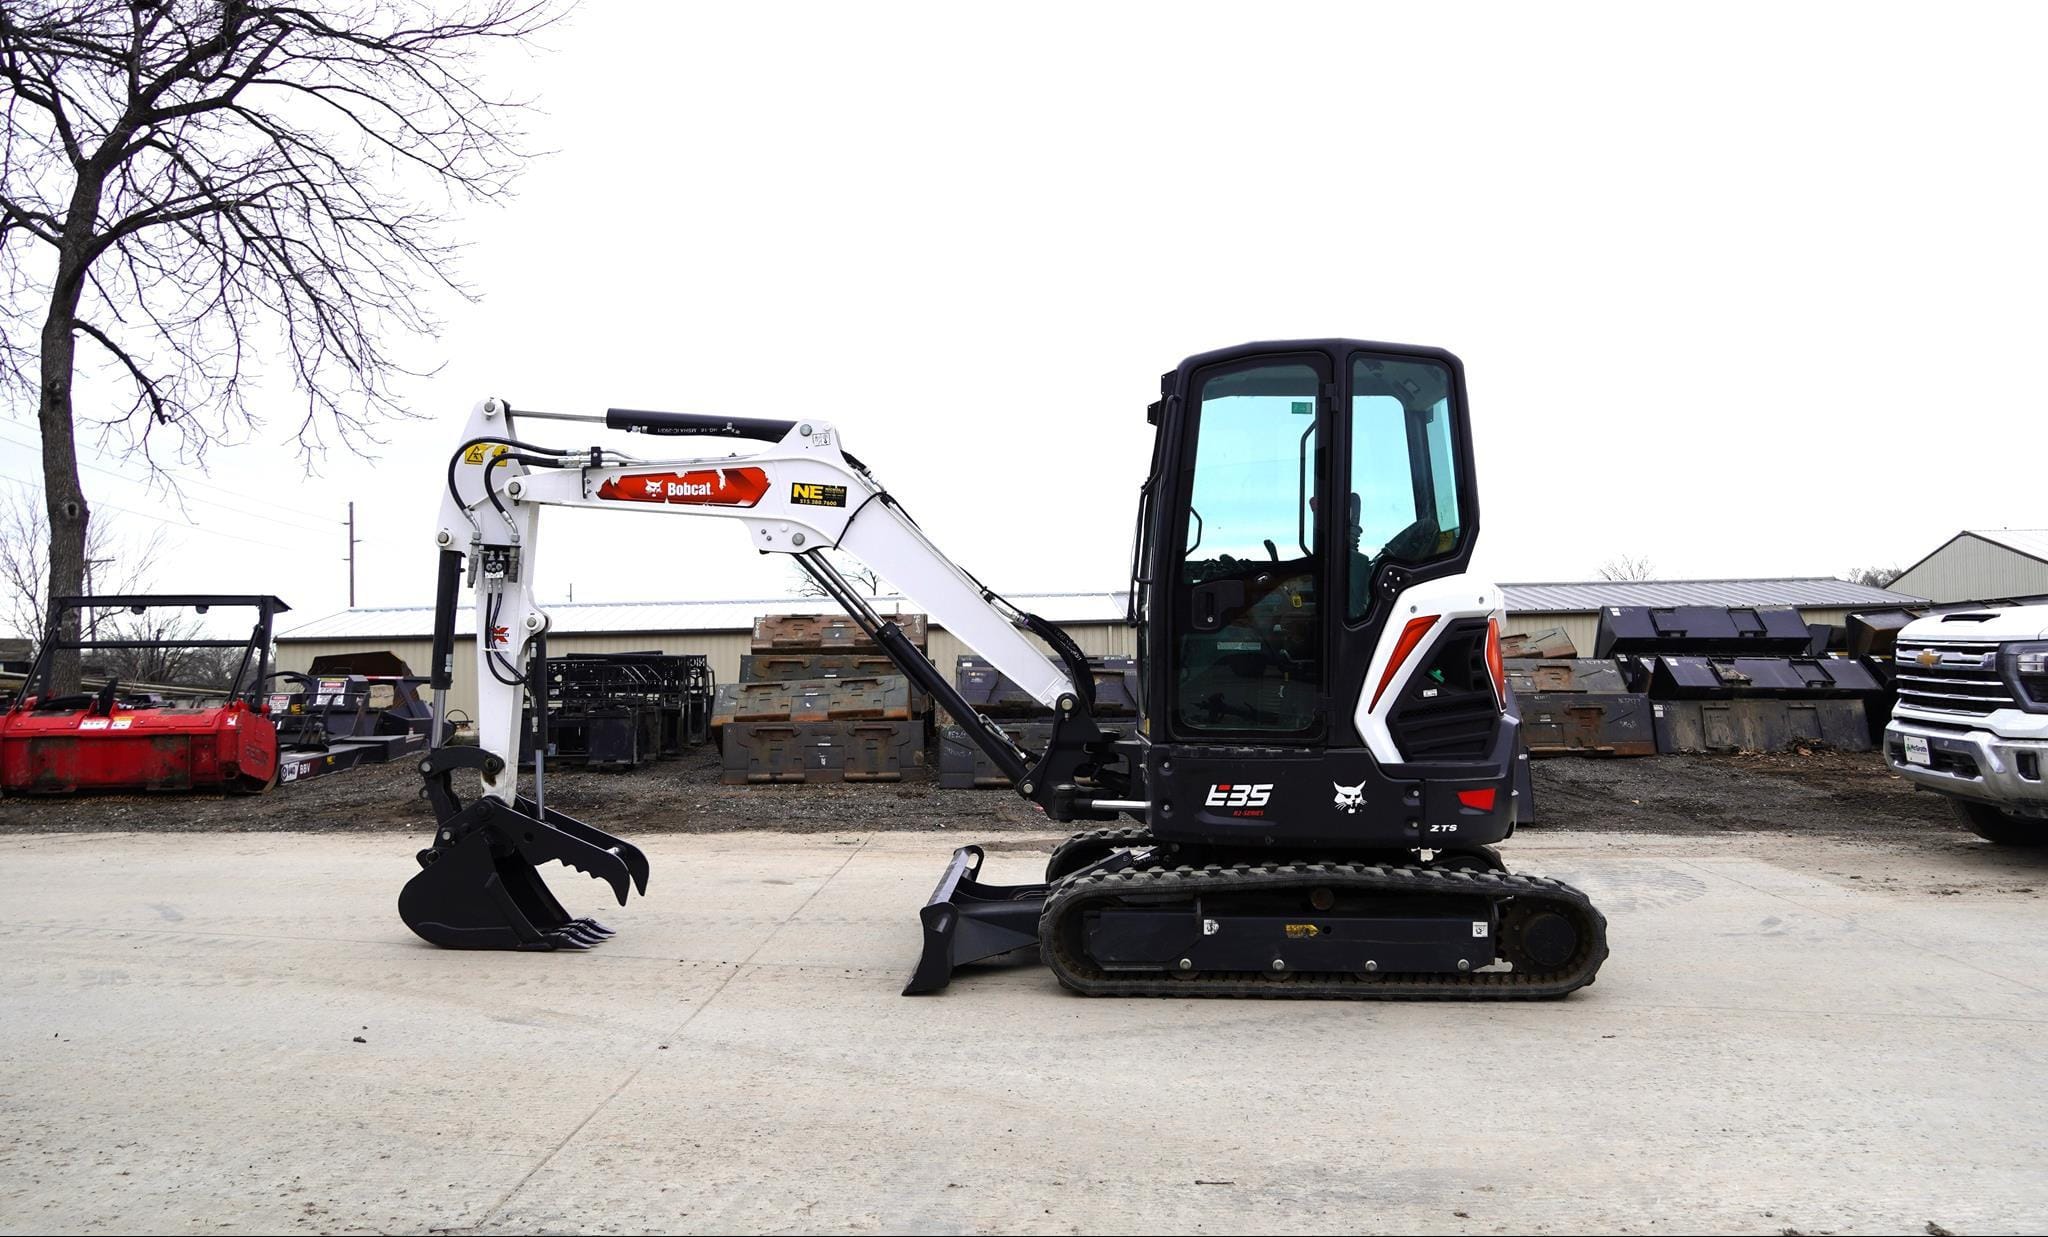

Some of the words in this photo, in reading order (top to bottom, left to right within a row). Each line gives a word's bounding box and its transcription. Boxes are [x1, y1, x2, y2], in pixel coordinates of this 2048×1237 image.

[667, 482, 711, 496] Bobcat
[793, 484, 823, 499] NE
[1205, 784, 1274, 807] E35
[1430, 824, 1458, 832] ZTS
